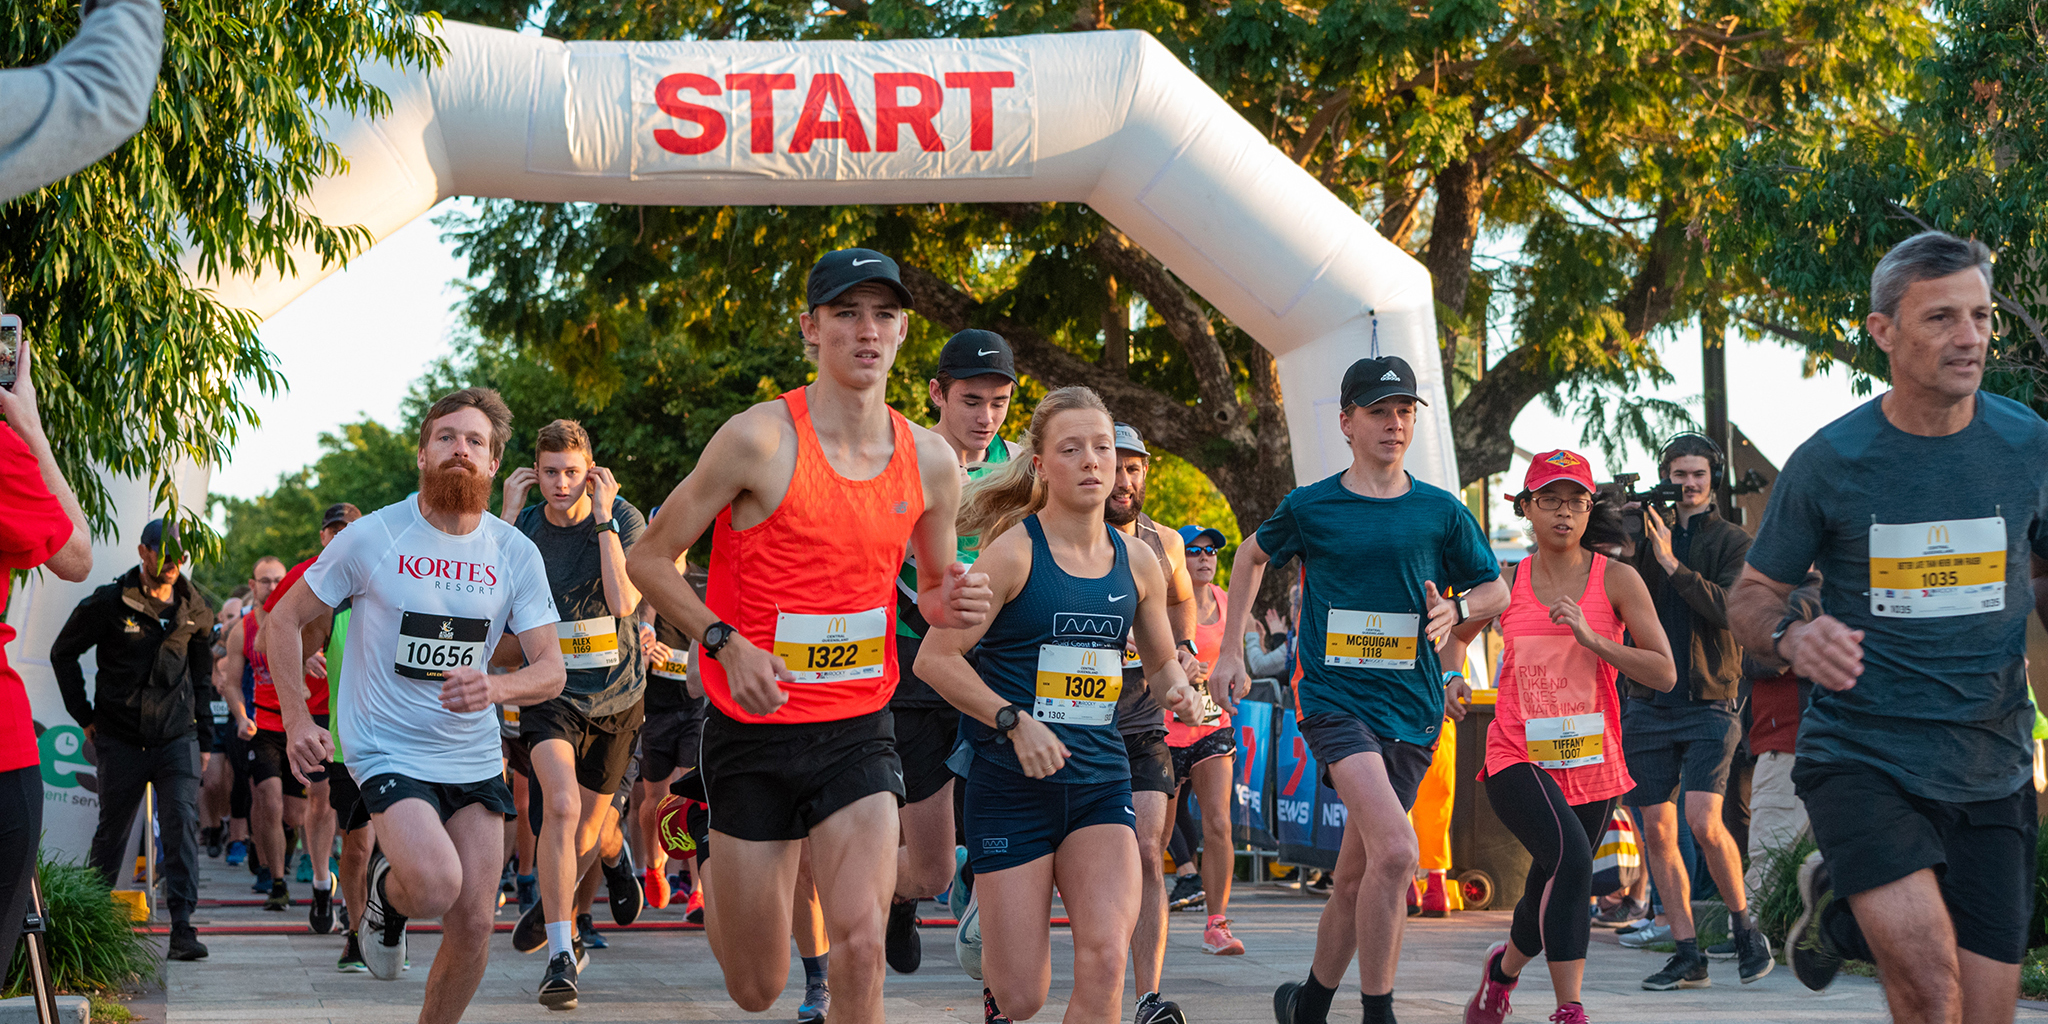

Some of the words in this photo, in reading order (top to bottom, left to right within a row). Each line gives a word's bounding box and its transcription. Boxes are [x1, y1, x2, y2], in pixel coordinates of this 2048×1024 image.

[653, 71, 1015, 155] START
[397, 555, 497, 586] KORTE'S
[1921, 571, 1958, 587] 1035
[435, 581, 494, 595] RESORT
[1890, 605, 1912, 614] 1035
[1981, 598, 2001, 608] 1035
[572, 637, 591, 646] ALEX
[1346, 635, 1399, 648] MCGUIGAN
[407, 642, 474, 667] 10656
[573, 645, 591, 653] 1169
[1362, 647, 1382, 657] 1118
[807, 644, 858, 668] 1322
[665, 662, 687, 673] 1324
[1518, 665, 1547, 678] RUN
[1065, 676, 1107, 699] 1302
[1520, 678, 1548, 691] LIKE
[1550, 677, 1568, 689] NO
[1523, 691, 1557, 703] ONE'S
[1048, 711, 1066, 719] 1302
[1524, 702, 1586, 716] WATCHING
[1552, 737, 1585, 750] TIFFANY
[1560, 748, 1581, 760] 1007
